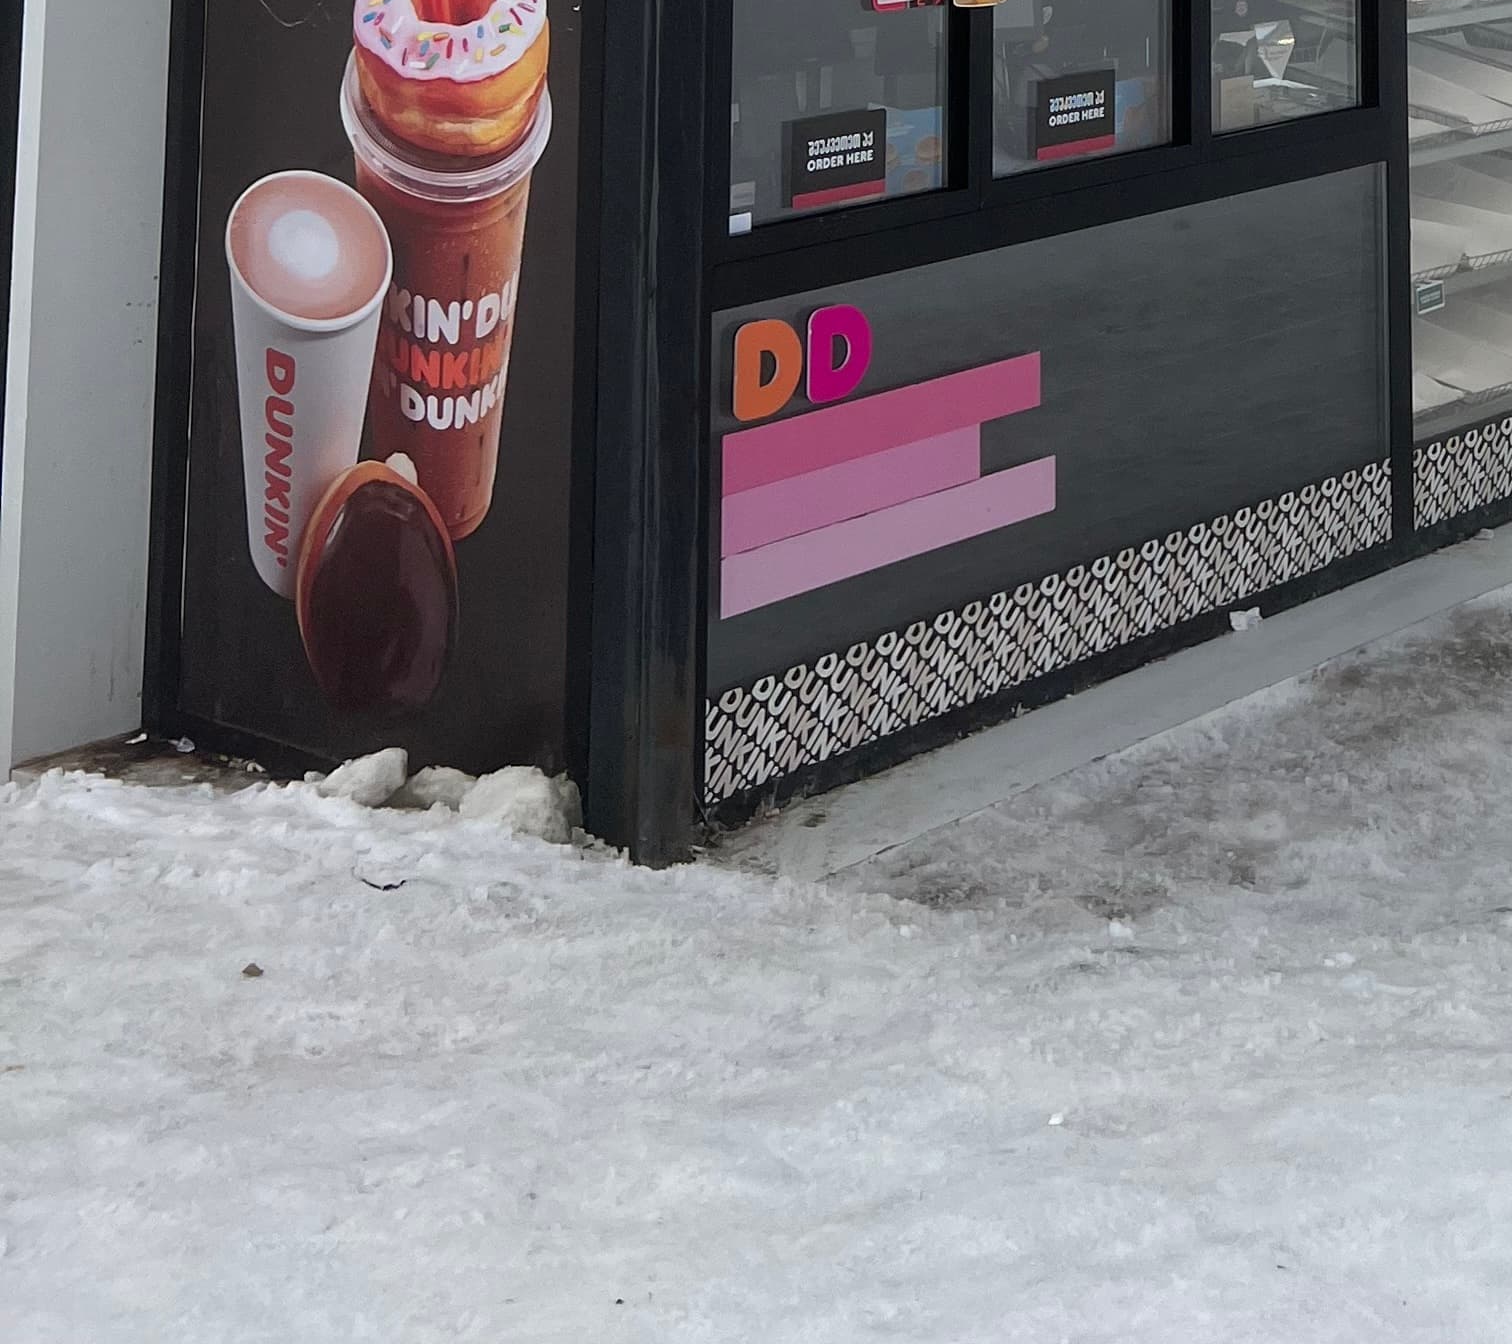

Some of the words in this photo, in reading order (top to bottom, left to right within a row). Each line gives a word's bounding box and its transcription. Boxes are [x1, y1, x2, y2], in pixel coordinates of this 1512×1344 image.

[1048, 112, 1080, 127] ORDER
[1081, 107, 1105, 121] HERE
[806, 155, 845, 173] ORDER
[846, 149, 874, 165] HERE
[264, 348, 296, 569] DUNKIN'
